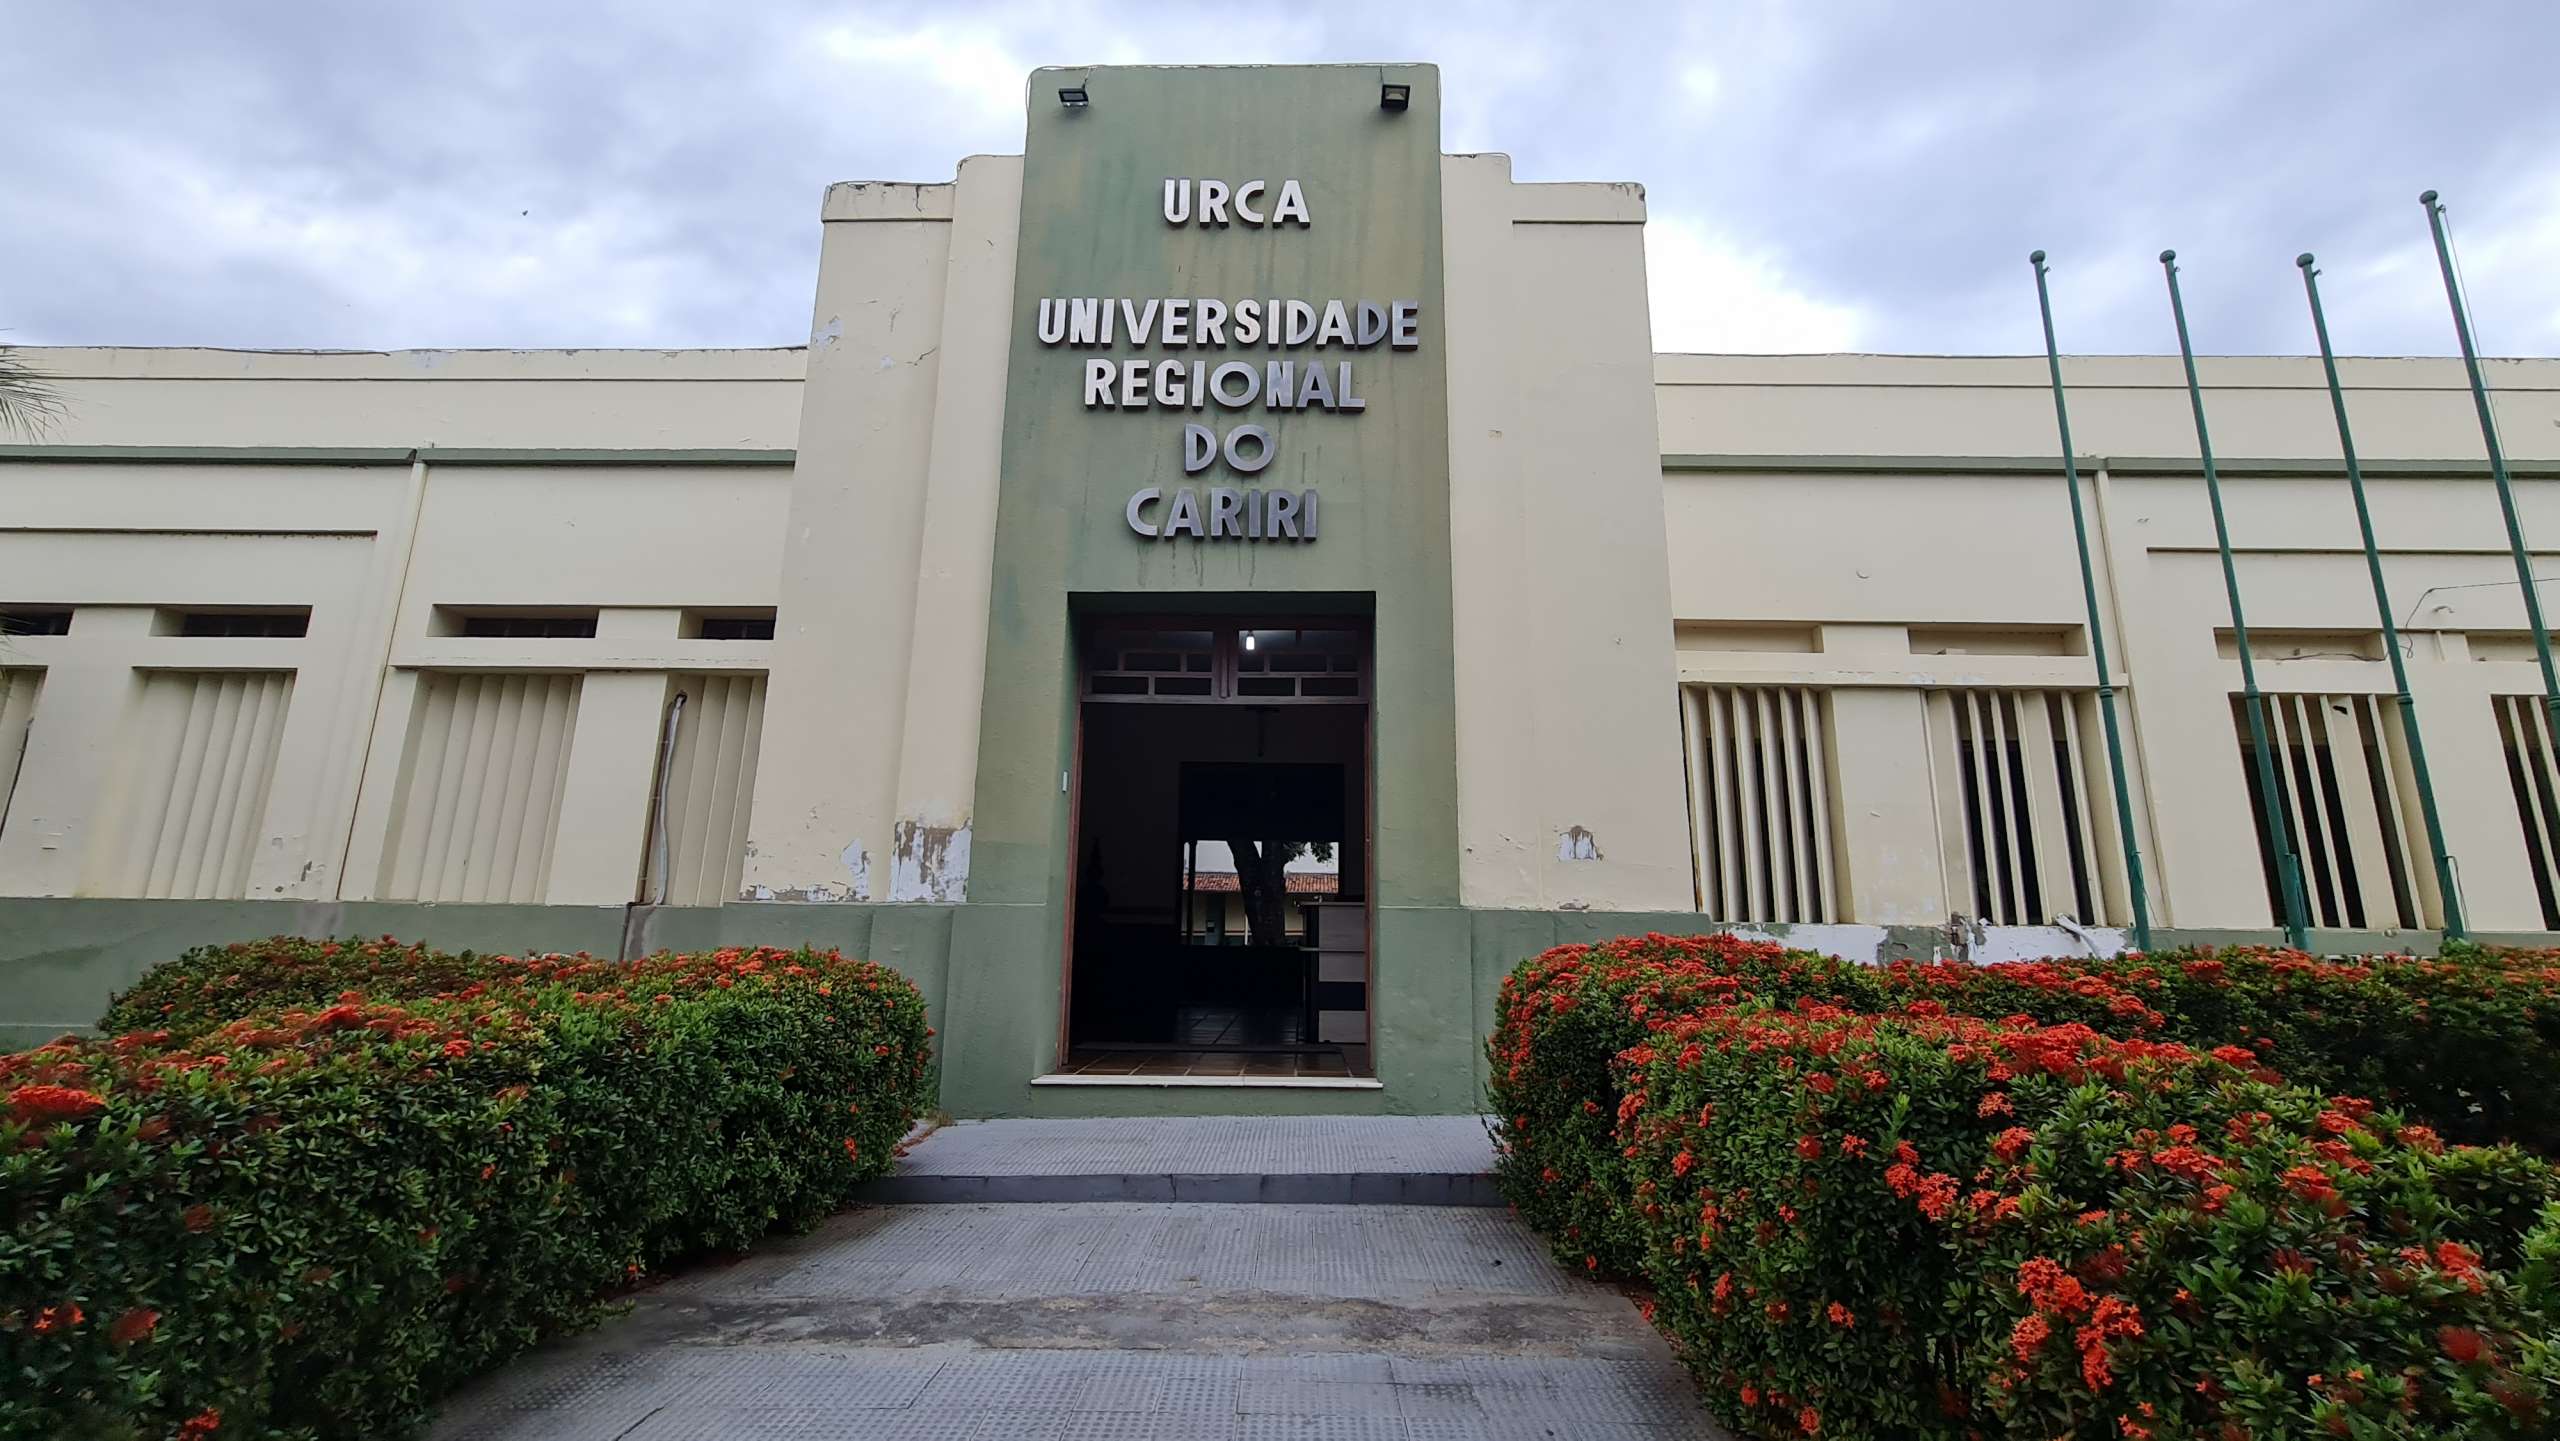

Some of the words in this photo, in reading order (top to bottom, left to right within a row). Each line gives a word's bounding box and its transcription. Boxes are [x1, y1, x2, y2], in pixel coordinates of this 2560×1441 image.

[1163, 179, 1311, 227] URCA
[1038, 298, 1419, 350] UNIVERSIDADE
[1084, 358, 1366, 411] REGIONAL
[1184, 423, 1276, 475] DO
[1125, 486, 1319, 541] CARIRI
